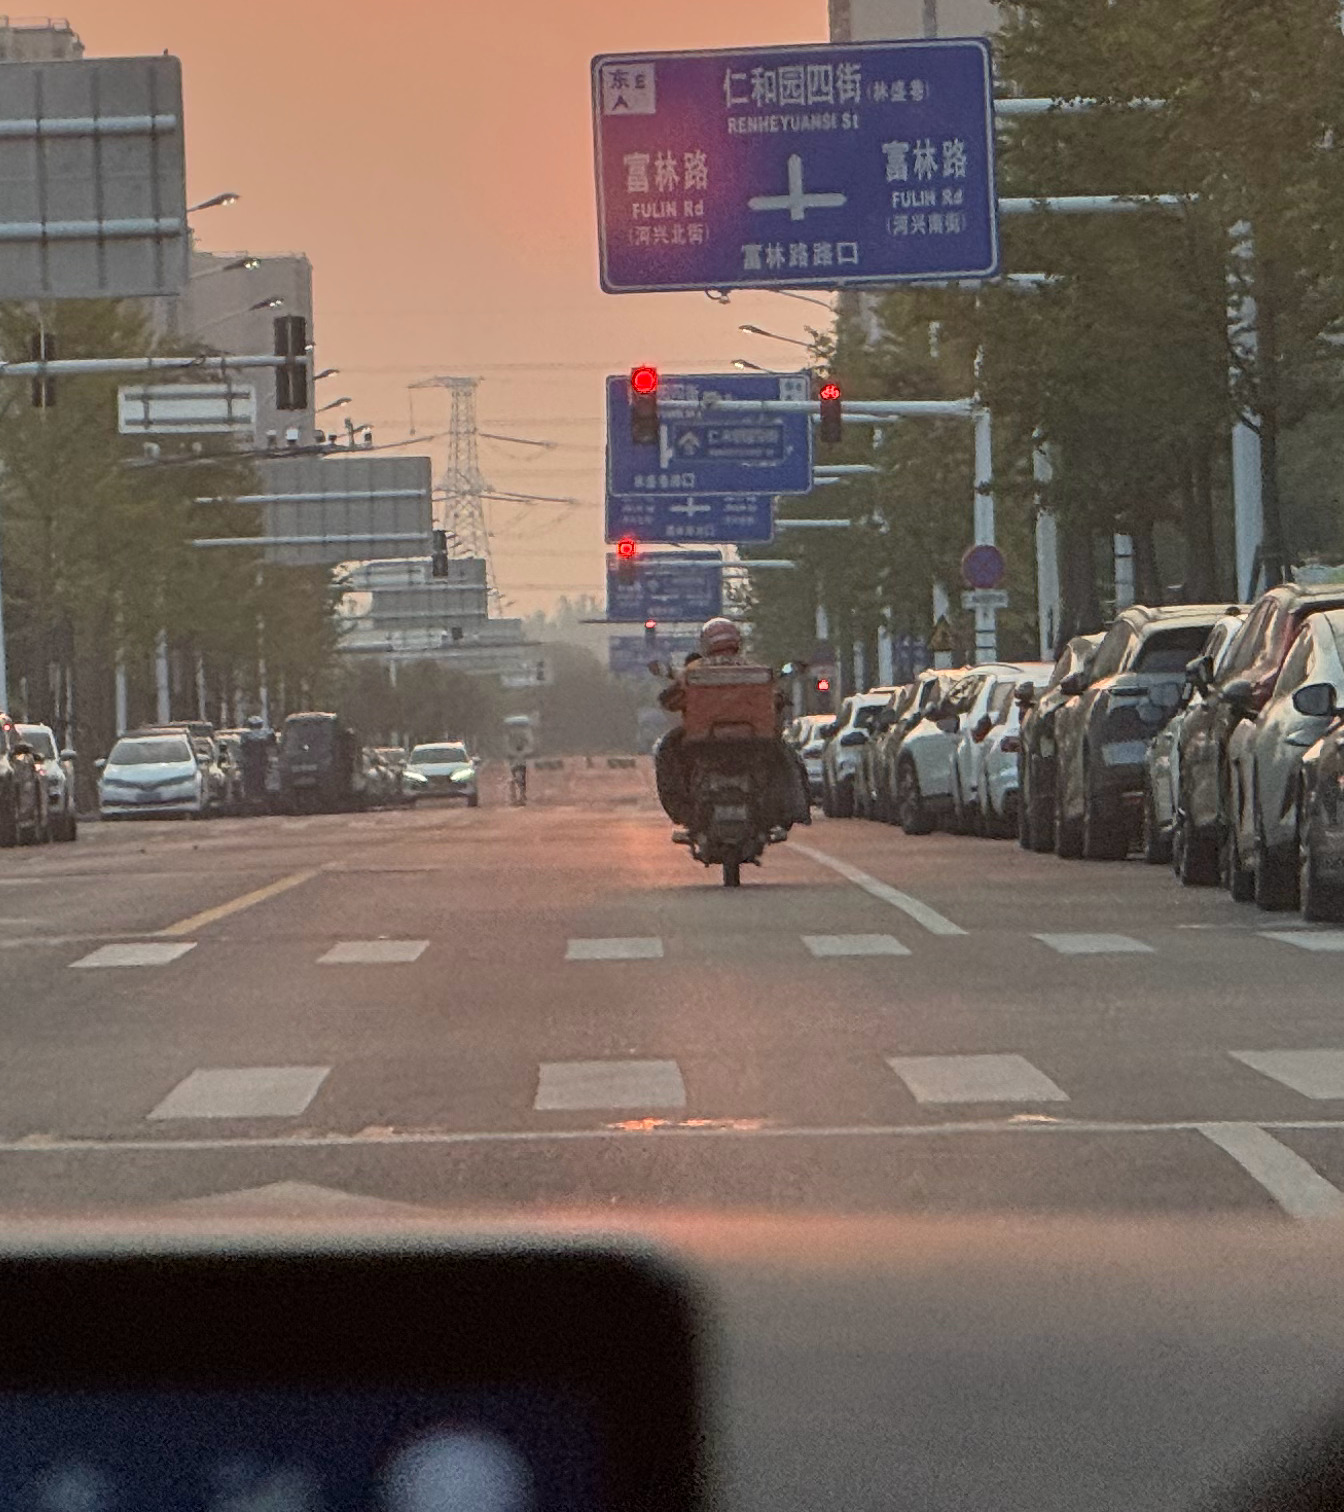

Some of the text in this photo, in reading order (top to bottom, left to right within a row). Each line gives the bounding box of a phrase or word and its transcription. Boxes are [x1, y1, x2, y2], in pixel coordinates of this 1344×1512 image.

[635, 74, 646, 89] E
[723, 62, 861, 108] 仁和园四街
[612, 95, 629, 110] A
[623, 149, 708, 193] 富林路
[881, 138, 967, 182] 富林路
[632, 199, 704, 219] FULIN Rd
[892, 188, 963, 208] FULIN Rd
[742, 242, 859, 270] 富林路路口
